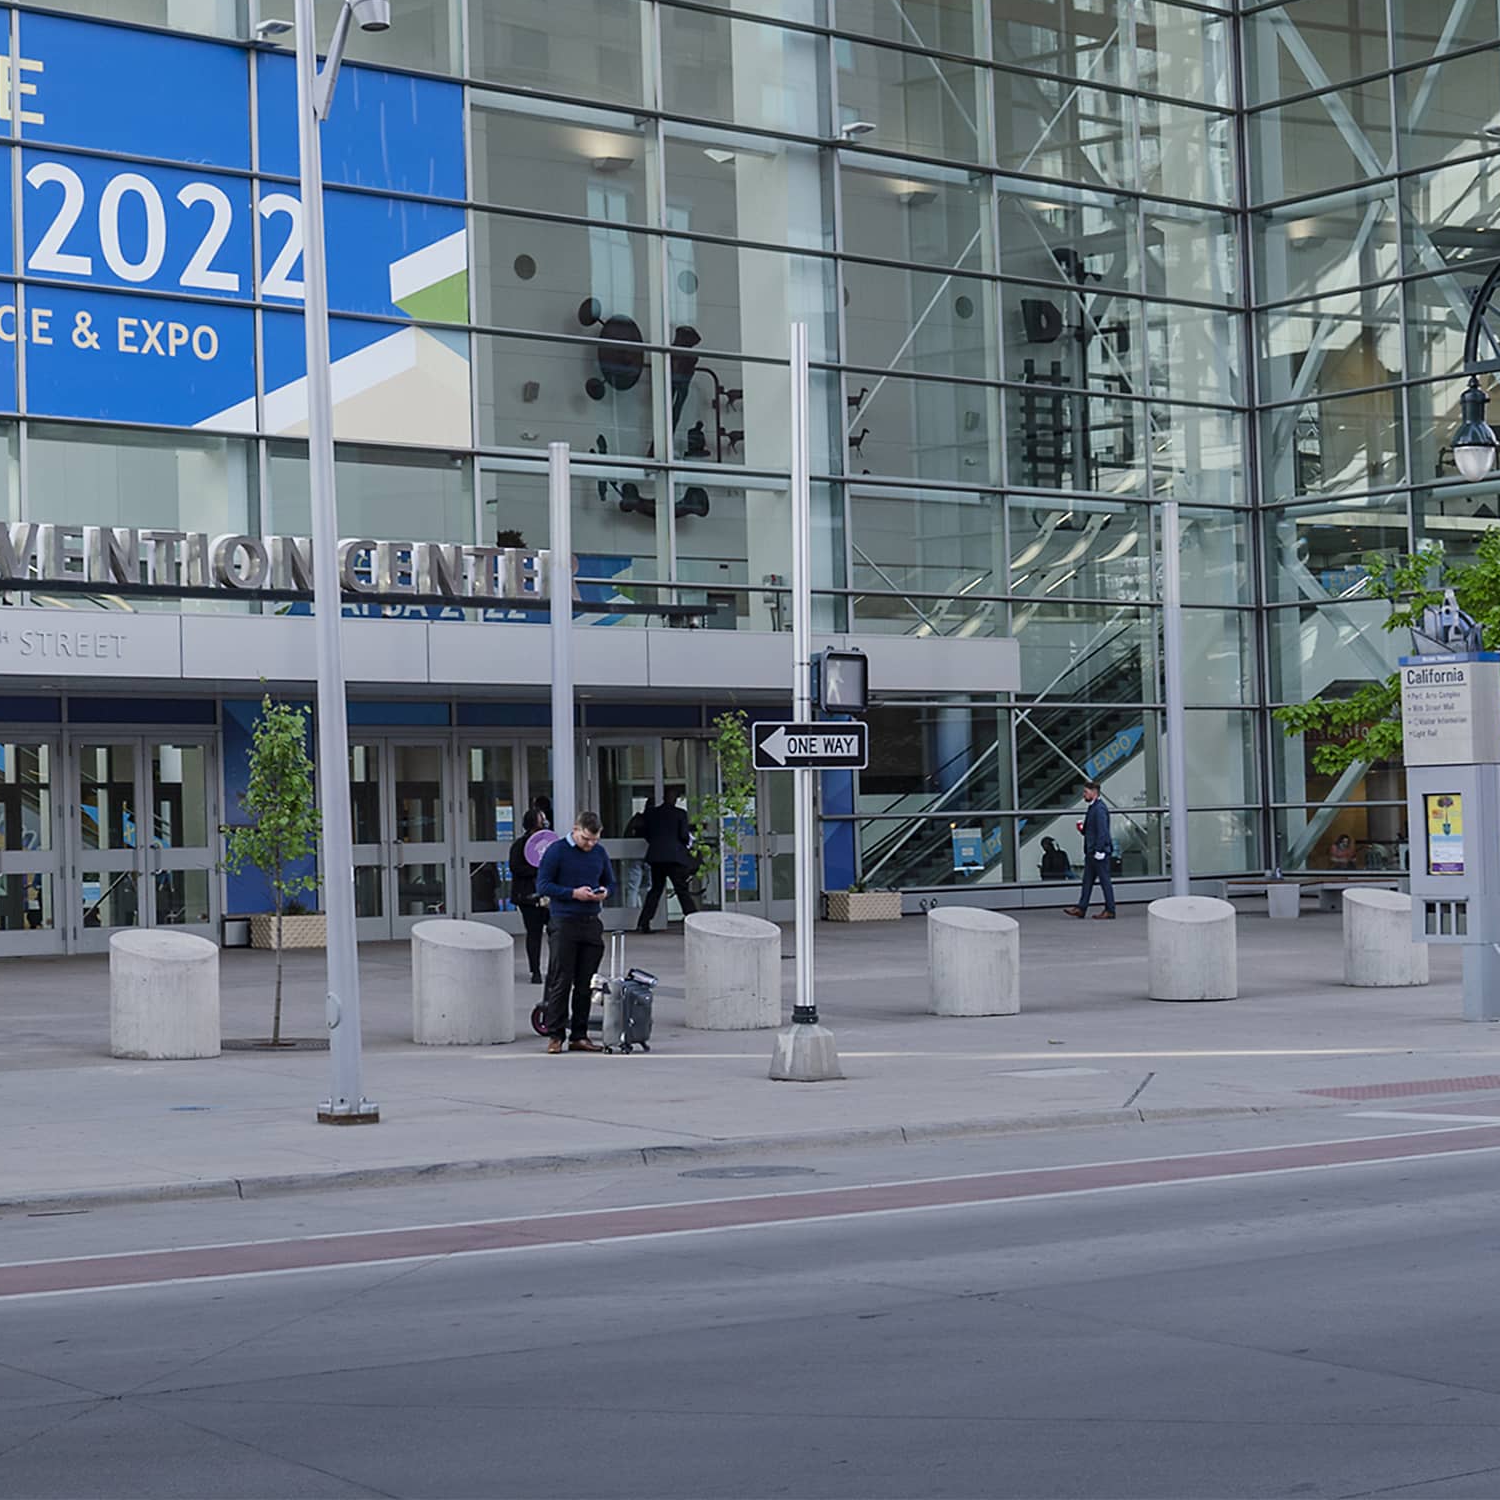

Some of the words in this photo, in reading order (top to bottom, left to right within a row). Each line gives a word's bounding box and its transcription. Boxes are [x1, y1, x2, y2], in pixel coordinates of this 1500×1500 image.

[25, 161, 306, 299] 2022
[71, 310, 101, 349] &
[117, 317, 220, 361] EXPO
[20, 629, 128, 659] STREET
[1406, 667, 1465, 685] California
[787, 737, 817, 754] ONE
[823, 737, 854, 754] WAY
[1093, 735, 1132, 772] EXPO
